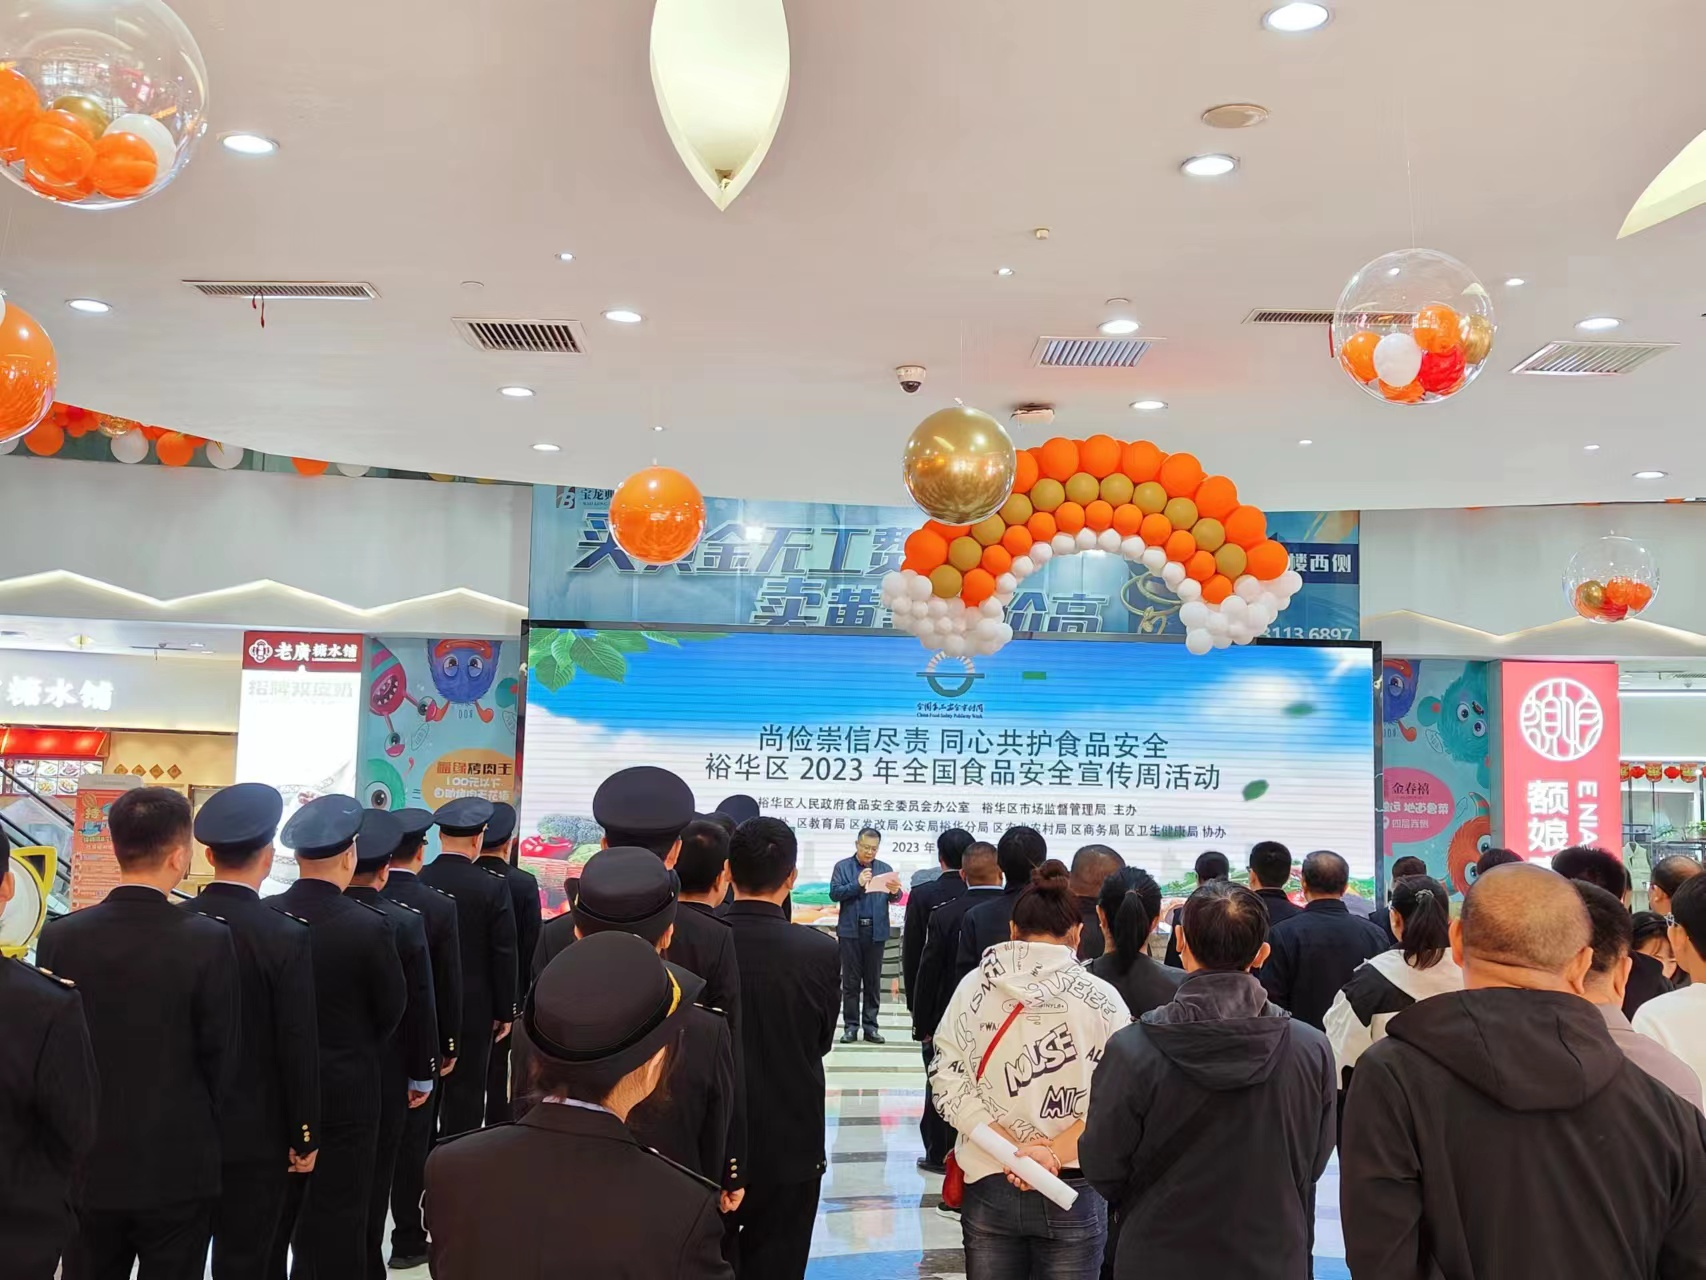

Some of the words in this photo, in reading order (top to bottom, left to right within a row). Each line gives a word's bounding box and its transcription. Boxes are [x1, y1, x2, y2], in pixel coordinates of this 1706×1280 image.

[1308, 628, 1352, 640] 6897
[0, 676, 114, 711] 糖水铺
[759, 724, 930, 755] 尚俭崇信尽责
[941, 727, 1169, 759] 同心共护食品安全
[705, 753, 790, 781] 裕华区
[800, 757, 863, 781] 2023
[872, 756, 1221, 790] 年全国食品安全宣传周活动
[757, 796, 971, 814] 裕华区人民政府食品安全委员会办公室
[981, 802, 1107, 816] 裕华区市场监督管理局
[1113, 803, 1137, 816] 主办
[1576, 781, 1599, 850] ENIA
[797, 817, 845, 830] 区教育局
[850, 818, 898, 832] 区发改局
[902, 819, 989, 833] 公安局裕华分局
[1071, 824, 1120, 837] 区商务局
[1124, 825, 1199, 838] 区卫生健康局
[1203, 825, 1227, 839] 协办
[1527, 780, 1569, 869] 额娘
[892, 841, 920, 853] 2023
[924, 841, 936, 854] 年
